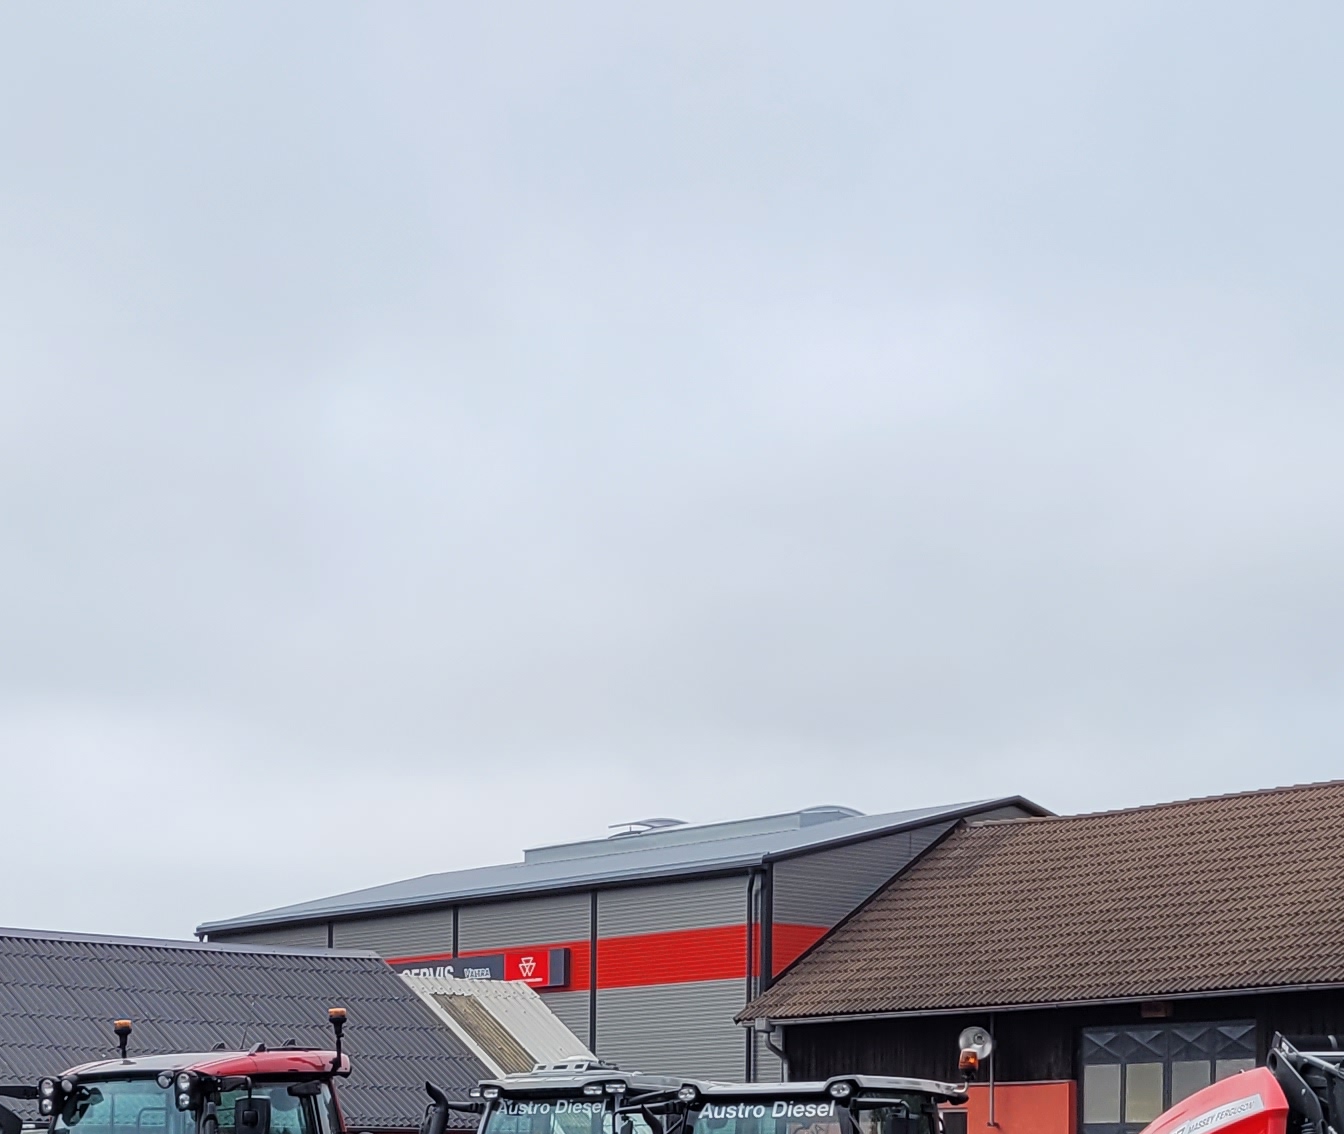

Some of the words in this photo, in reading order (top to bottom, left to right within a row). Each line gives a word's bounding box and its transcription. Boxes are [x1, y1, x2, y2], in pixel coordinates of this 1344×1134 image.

[463, 967, 491, 979] VALTRA
[496, 1099, 551, 1115] Austro
[555, 1099, 607, 1116] Diesel
[698, 1102, 765, 1119] Austro
[771, 1100, 836, 1118] Diesel
[1187, 1114, 1216, 1134] MASSEY
[1215, 1101, 1256, 1122] FERGUSON
